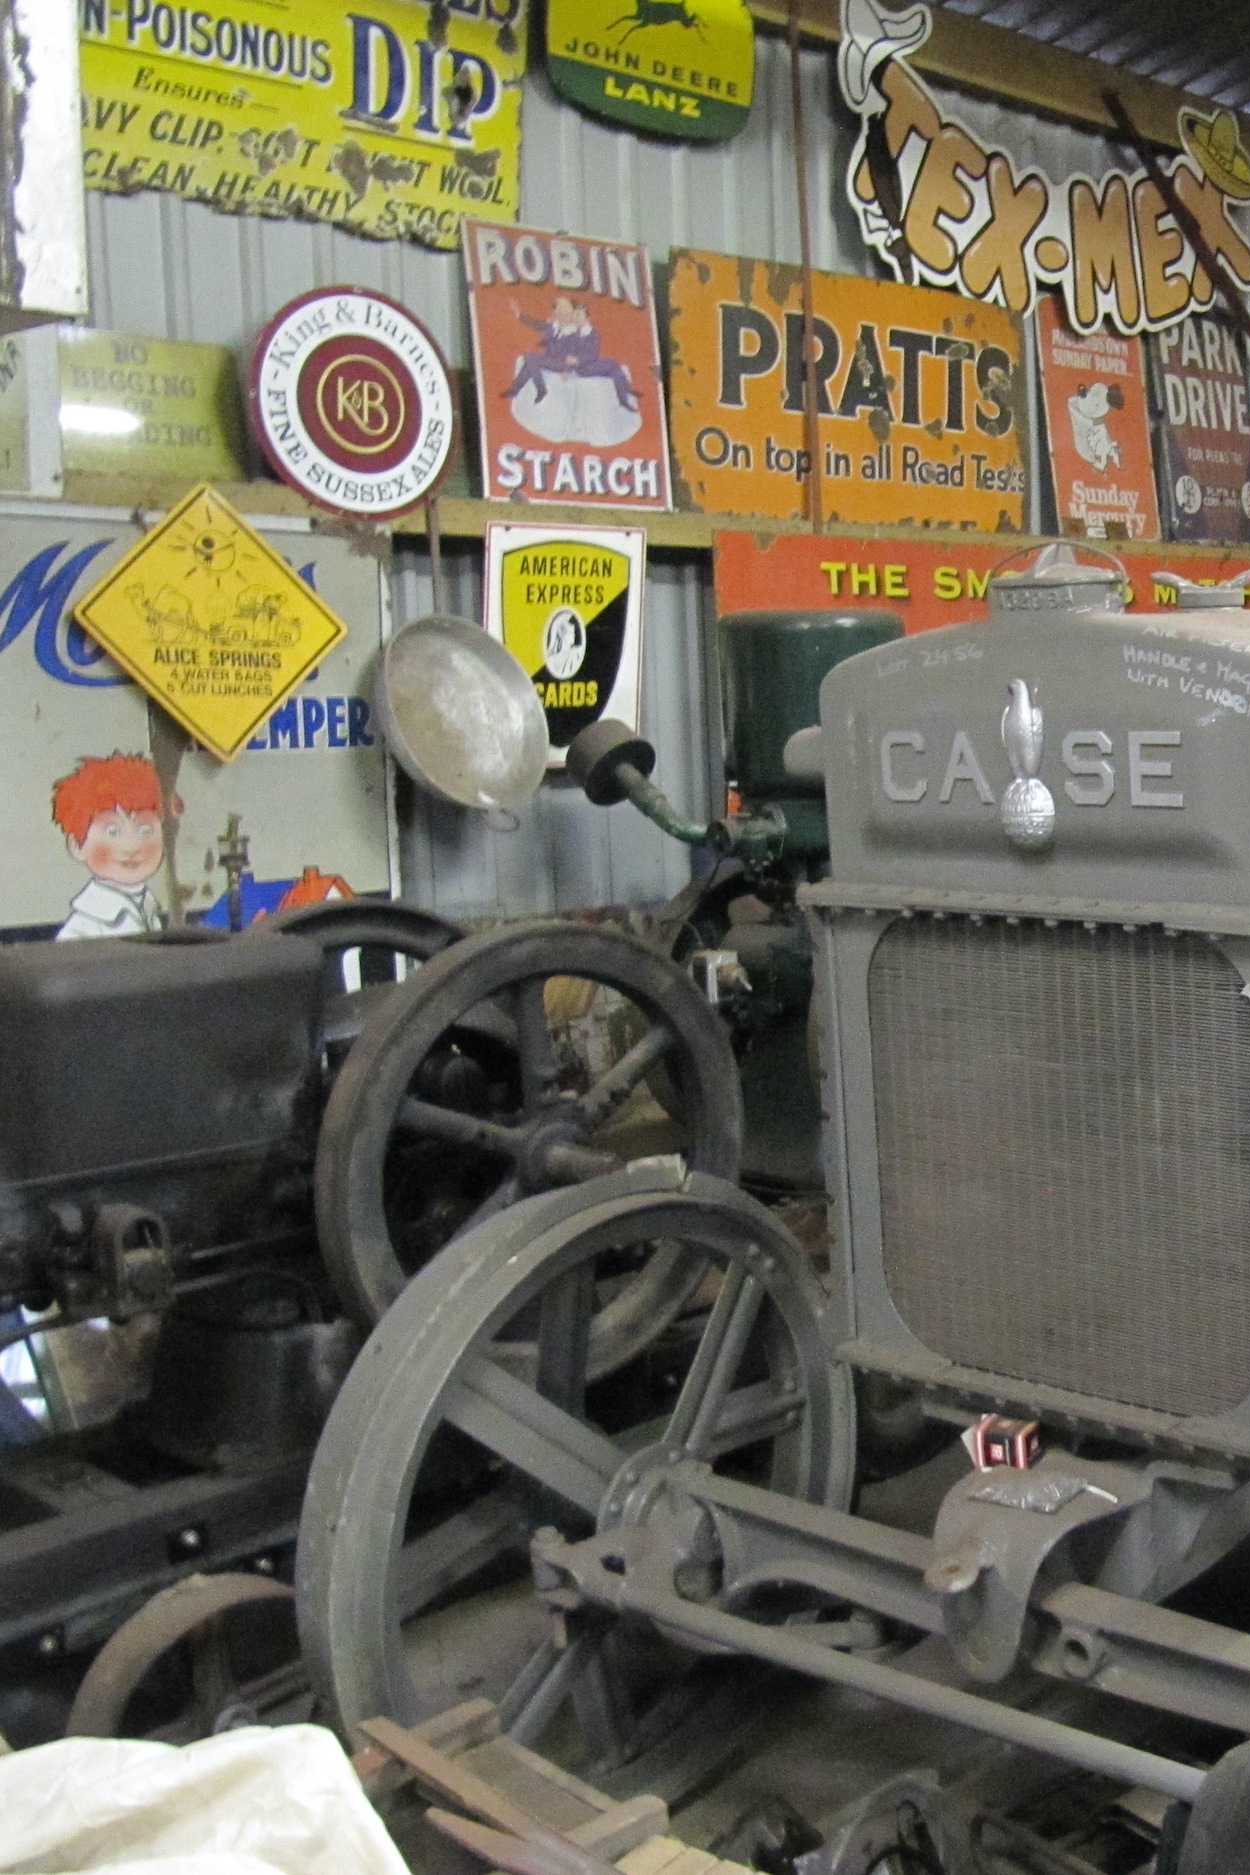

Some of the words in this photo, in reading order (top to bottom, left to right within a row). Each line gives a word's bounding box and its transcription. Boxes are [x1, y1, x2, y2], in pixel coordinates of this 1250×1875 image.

[338, 13, 500, 141] DIP
[565, 37, 640, 71] JOHN
[652, 59, 739, 97] DEERE
[603, 76, 703, 119] LANZ
[475, 225, 646, 310] ROBIN
[268, 305, 333, 371] King
[364, 302, 438, 395] Barnes
[1159, 315, 1244, 378] PARK
[267, 387, 308, 465] FINE
[306, 462, 414, 504] SUSSEX
[411, 418, 445, 485] ALES
[496, 442, 660, 499] STARCH
[695, 425, 752, 471] On
[765, 435, 812, 483] top
[824, 442, 850, 477] in
[860, 443, 892, 481] all
[902, 445, 965, 488] Road
[1072, 480, 1140, 514] Sunday
[519, 555, 613, 578] AMERICAN
[526, 583, 605, 605] EXPRESS
[819, 561, 910, 598] THE
[154, 646, 199, 665] ALICE
[208, 649, 282, 669] SPRINGS
[879, 729, 1186, 809] CASE
